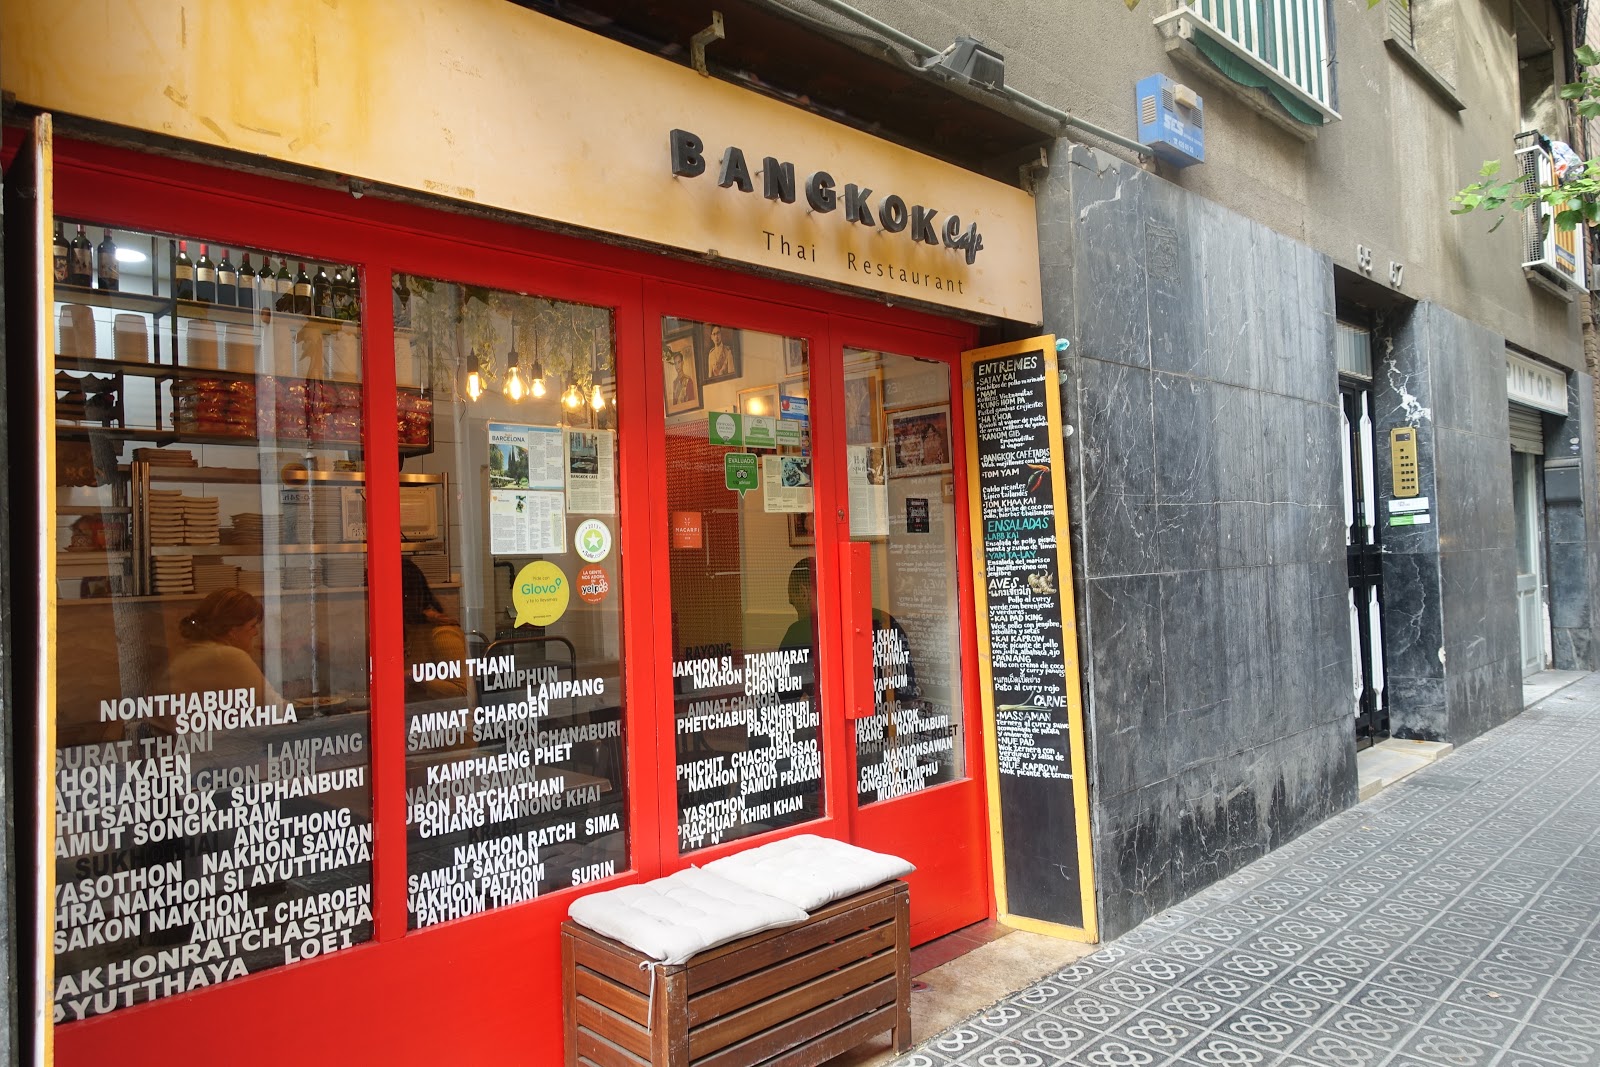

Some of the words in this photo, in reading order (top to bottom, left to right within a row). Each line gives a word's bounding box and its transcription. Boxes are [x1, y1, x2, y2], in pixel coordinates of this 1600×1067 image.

[670, 128, 939, 245] BANGKOK
[763, 230, 815, 263] Thai
[848, 252, 964, 295] Restaurant
[1357, 244, 1372, 271] 65
[1389, 261, 1403, 287] 67
[979, 356, 1037, 376] ENTREMES
[982, 432, 1008, 442] KANOM
[984, 451, 1016, 462] BANGKOK
[984, 470, 999, 478] TOM
[1000, 468, 1020, 477] YAM
[985, 500, 1000, 508] TOM
[988, 517, 1049, 532] ENSALADAS
[988, 552, 1006, 560] YAM
[1007, 550, 1036, 559] TA-LAY
[522, 584, 556, 595] Glovo
[582, 584, 600, 595] yelp
[988, 577, 1020, 590] AVES
[877, 628, 898, 642] KHAI
[1008, 621, 1022, 630] pollo
[1010, 642, 1032, 650] picante
[1042, 638, 1058, 650] pollo
[412, 660, 460, 682] UDON
[466, 654, 515, 677] THANI
[722, 656, 732, 672] SI
[744, 649, 810, 668] THAMMARAT
[996, 654, 1032, 662] PANANG
[1040, 660, 1048, 668] de
[484, 666, 558, 692] LAMPHUN
[527, 678, 604, 702] LAMPANG
[694, 669, 742, 690] NAKHON
[746, 664, 790, 682] PHANOM
[744, 679, 775, 696] CHON
[778, 676, 802, 692] BURI
[1022, 686, 1042, 694] curry
[1044, 684, 1060, 694] rojo
[100, 687, 255, 722] NONTHABURI
[688, 698, 728, 718] AMNAT
[1034, 694, 1068, 708] CARNE
[175, 703, 297, 735] SONGKHLA
[409, 708, 468, 734] AMNAT
[474, 700, 549, 725] CHAROEN
[677, 708, 758, 734] PHETCHABURI
[760, 701, 810, 721] SINGBURI
[748, 716, 793, 738] PRACHIN
[796, 712, 820, 730] BURI
[891, 708, 918, 726] NAYOK
[896, 715, 948, 736] NONTHABURI
[1000, 710, 1052, 722] MASSAMAN
[1032, 721, 1051, 729] curry
[140, 731, 213, 759] THANI
[407, 726, 468, 751] SAMUT
[472, 717, 538, 742] SAKHON
[506, 720, 620, 753] KANCHANABURI
[769, 729, 795, 746] TRAT
[1002, 737, 1018, 746] NUE
[1020, 738, 1034, 746] PAD
[268, 732, 363, 763] LAMPANG
[676, 756, 724, 781] PHICHIT
[731, 739, 818, 768] CHACHOENGSAO
[884, 736, 952, 763] NAKHONSAWAN
[1055, 752, 1064, 761] de
[125, 753, 191, 783] KAEN
[196, 764, 260, 791] CHON
[268, 753, 316, 783] BURI
[427, 750, 530, 786] KAMPHAENG
[534, 742, 572, 766] PHET
[688, 772, 738, 792] NAKHON
[741, 760, 778, 781] NAYOK
[861, 756, 918, 780] CHAIYAPHUM
[1002, 761, 1020, 770] NUE
[1022, 762, 1058, 772] KAPROW
[1016, 768, 1040, 777] picante
[230, 767, 364, 808] SUPHANBURI
[480, 765, 536, 791] SAWAN
[740, 776, 778, 796] SAMUT
[780, 765, 822, 786] PRAKAN
[877, 778, 925, 802] MUKDAHAN
[456, 776, 564, 816] RATCHATHANI
[683, 795, 746, 823] YASOTHON
[420, 808, 484, 839] CHIANG
[490, 802, 518, 824] MAI
[518, 794, 562, 818] NONG
[566, 784, 600, 808] KHAI
[740, 803, 770, 824] KHIRI
[774, 795, 803, 816] KHAN
[134, 800, 280, 846] SONGKHRAM
[234, 808, 350, 849] ANGTHONG
[202, 838, 296, 875] NAKHON
[302, 824, 372, 855] SAWAN
[454, 833, 522, 866] NAKHON
[528, 822, 576, 848] RATCH
[585, 812, 620, 836] SIMA
[114, 875, 216, 918] NAKHON
[224, 869, 244, 893] SI
[251, 844, 370, 888] AYUTTHAYA
[408, 864, 468, 894] SAMUT
[472, 846, 538, 878] SAKHON
[482, 863, 544, 893] PATHOM
[572, 860, 614, 886] SURIN
[190, 906, 268, 944] AMNAT
[274, 884, 370, 924] CHAROEN
[416, 895, 486, 929] PATHUM
[490, 880, 539, 910] THANI
[54, 914, 140, 955] SAKON
[150, 890, 248, 933] NAKHON
[284, 928, 352, 965] LOEI
